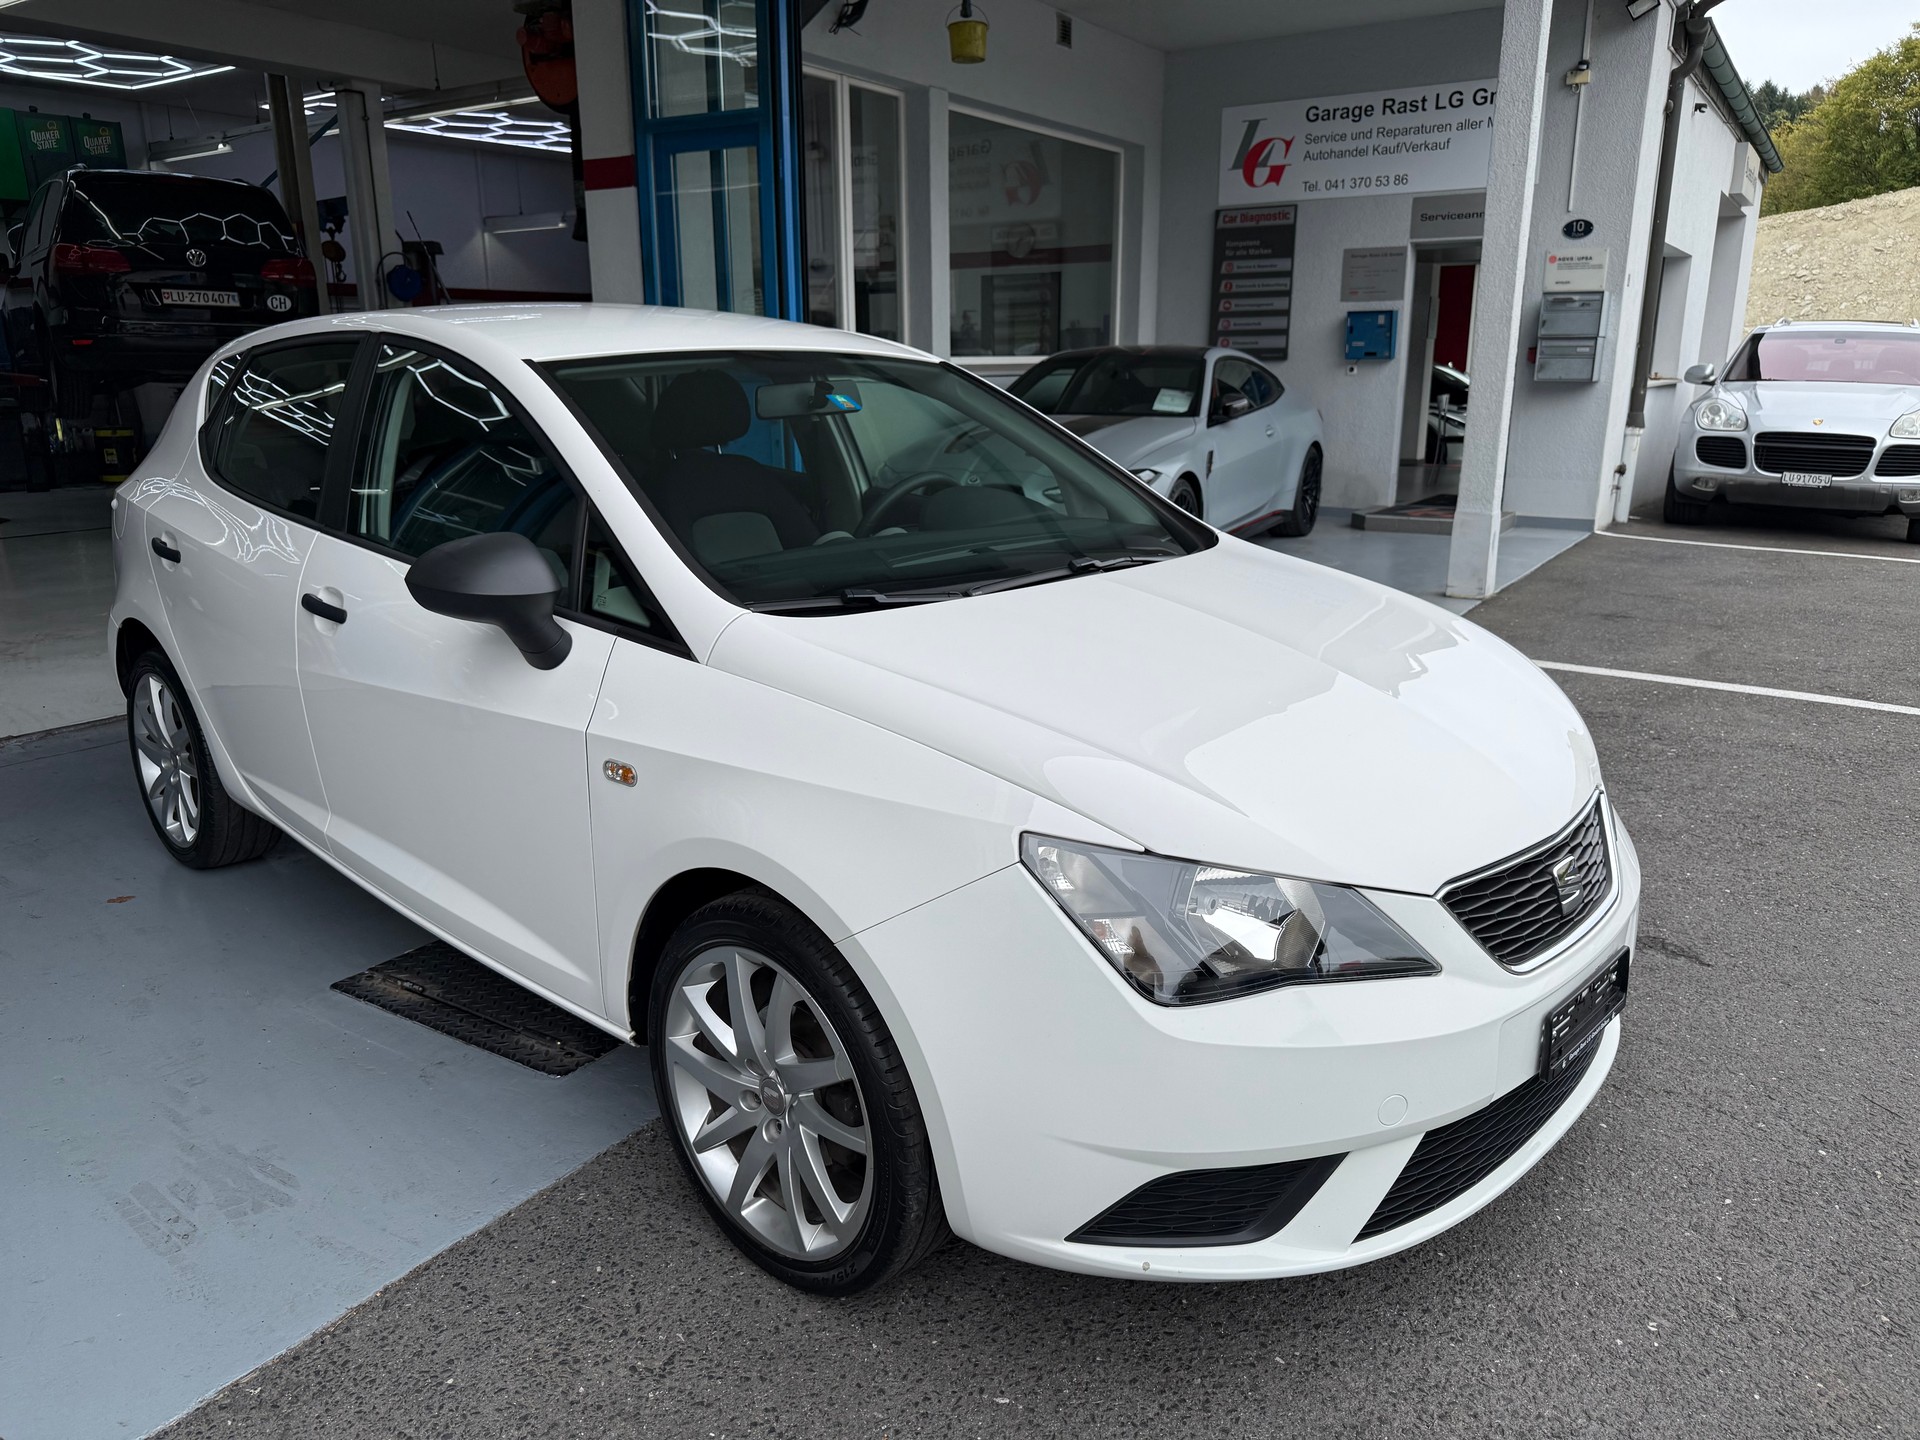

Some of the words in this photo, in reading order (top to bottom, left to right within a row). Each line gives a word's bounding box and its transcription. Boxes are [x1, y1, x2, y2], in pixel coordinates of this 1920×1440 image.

[1305, 104, 1375, 123] Garage
[1382, 95, 1428, 116] Rast
[1435, 90, 1464, 110] LG
[30, 129, 60, 144] QUAKER
[1304, 131, 1347, 145] Service
[1350, 128, 1373, 141] und
[1376, 122, 1452, 139] Reparaturen
[1456, 118, 1484, 131] aller
[36, 139, 59, 151] STATE
[83, 135, 112, 150] QUAKER
[1303, 145, 1369, 161] Autohandel
[1371, 137, 1452, 156] Kauf/Verkauf
[89, 145, 110, 156] STATE
[1302, 180, 1320, 192] Tel.
[1324, 178, 1345, 191] 041
[1349, 176, 1372, 189] 370
[1375, 175, 1390, 187] 53
[1393, 173, 1409, 186] 86
[1223, 214, 1238, 225] Car
[1240, 210, 1291, 225] Diagnostic
[1572, 220, 1585, 232] 10
[270, 296, 287, 310] CH
